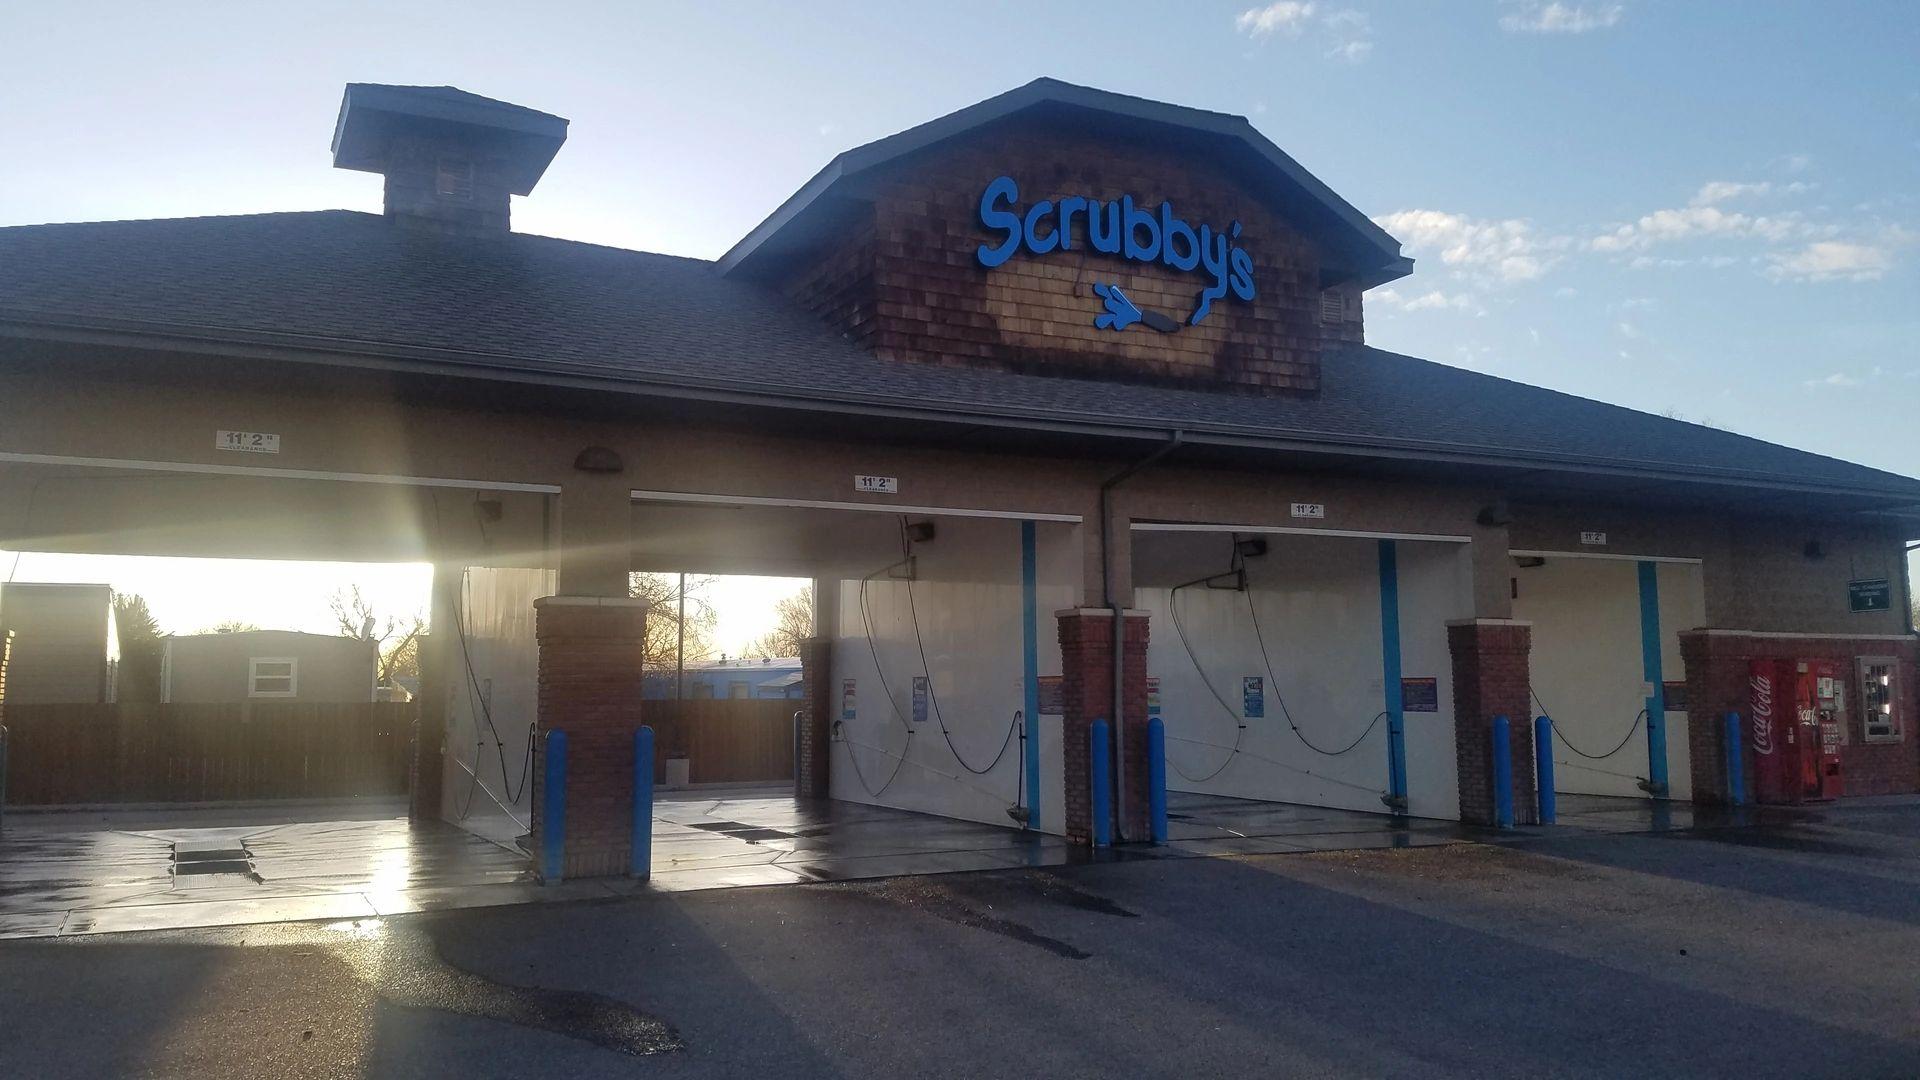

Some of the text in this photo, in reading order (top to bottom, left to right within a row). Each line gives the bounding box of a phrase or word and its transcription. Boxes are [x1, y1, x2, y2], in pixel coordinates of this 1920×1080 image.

[976, 175, 1256, 326] Scrubby's
[226, 432, 247, 445] 11'
[861, 476, 876, 487] 11'
